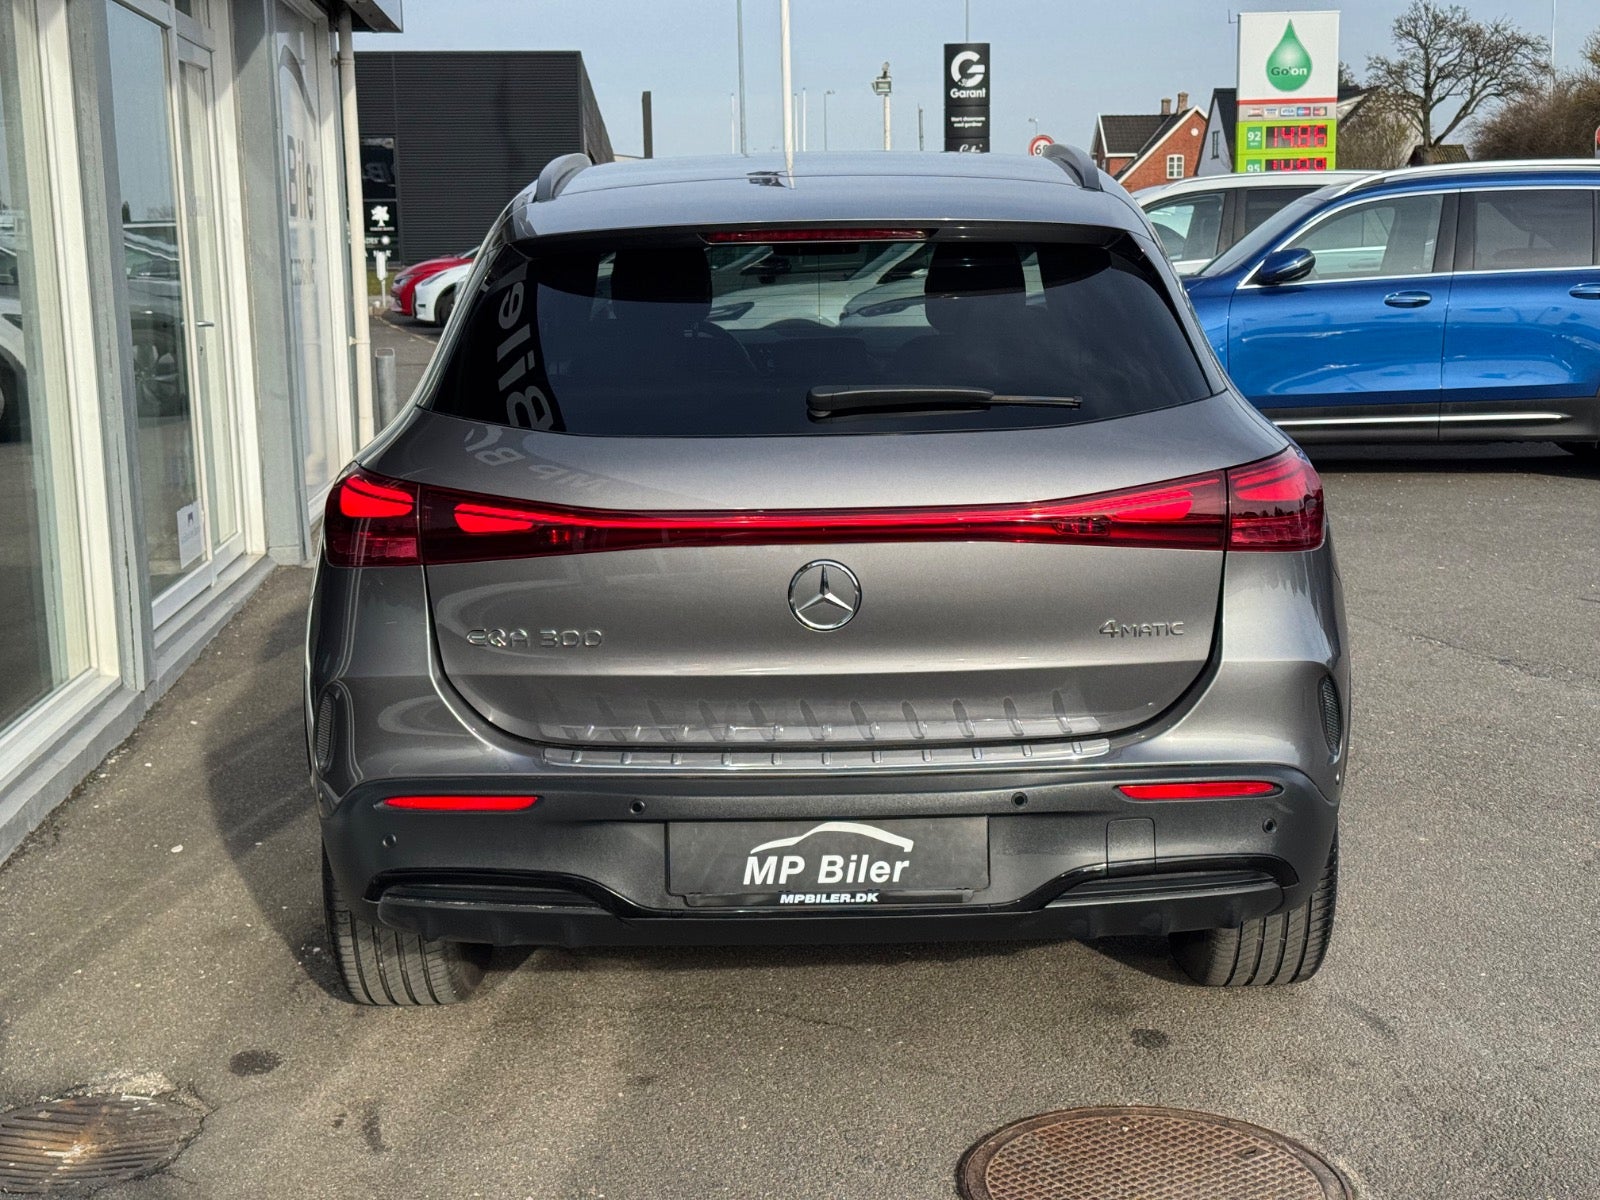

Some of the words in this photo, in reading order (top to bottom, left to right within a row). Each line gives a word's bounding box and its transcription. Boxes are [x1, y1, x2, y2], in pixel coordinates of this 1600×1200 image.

[950, 88, 986, 98] Garant
[1247, 131, 1261, 141] 92
[1098, 619, 1185, 639] 4MATIC
[466, 628, 531, 647] EQA
[539, 629, 604, 647] 300
[743, 855, 806, 886] MP
[817, 854, 910, 884] Biler
[780, 892, 879, 904] MPBILER.DK
